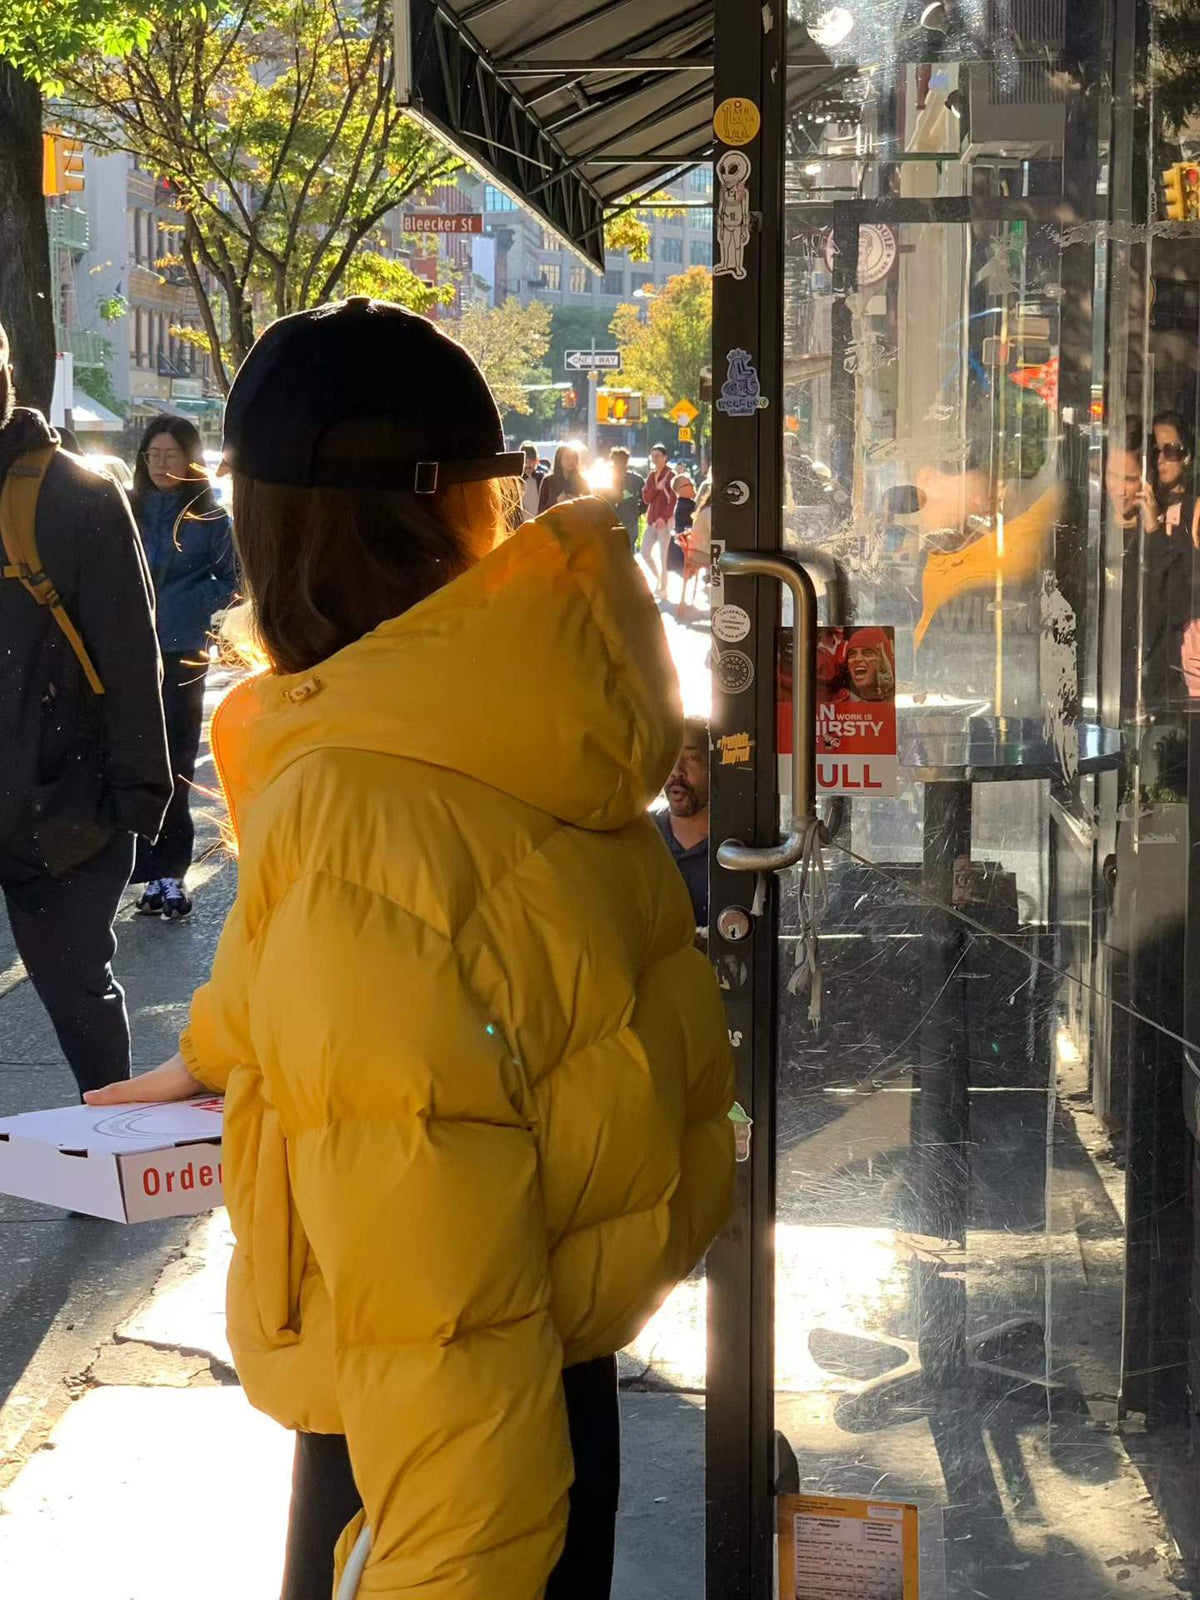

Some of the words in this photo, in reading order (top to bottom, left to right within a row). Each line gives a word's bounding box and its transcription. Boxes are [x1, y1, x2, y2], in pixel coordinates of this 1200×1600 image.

[404, 217, 456, 231] Bleecker
[461, 216, 473, 231] St
[572, 356, 589, 365] ONE
[598, 356, 616, 365] WAY
[816, 704, 835, 721] N
[836, 713, 862, 721] WORK
[865, 713, 873, 721] IS
[816, 721, 884, 736] IRSTY
[817, 764, 882, 788] ULL
